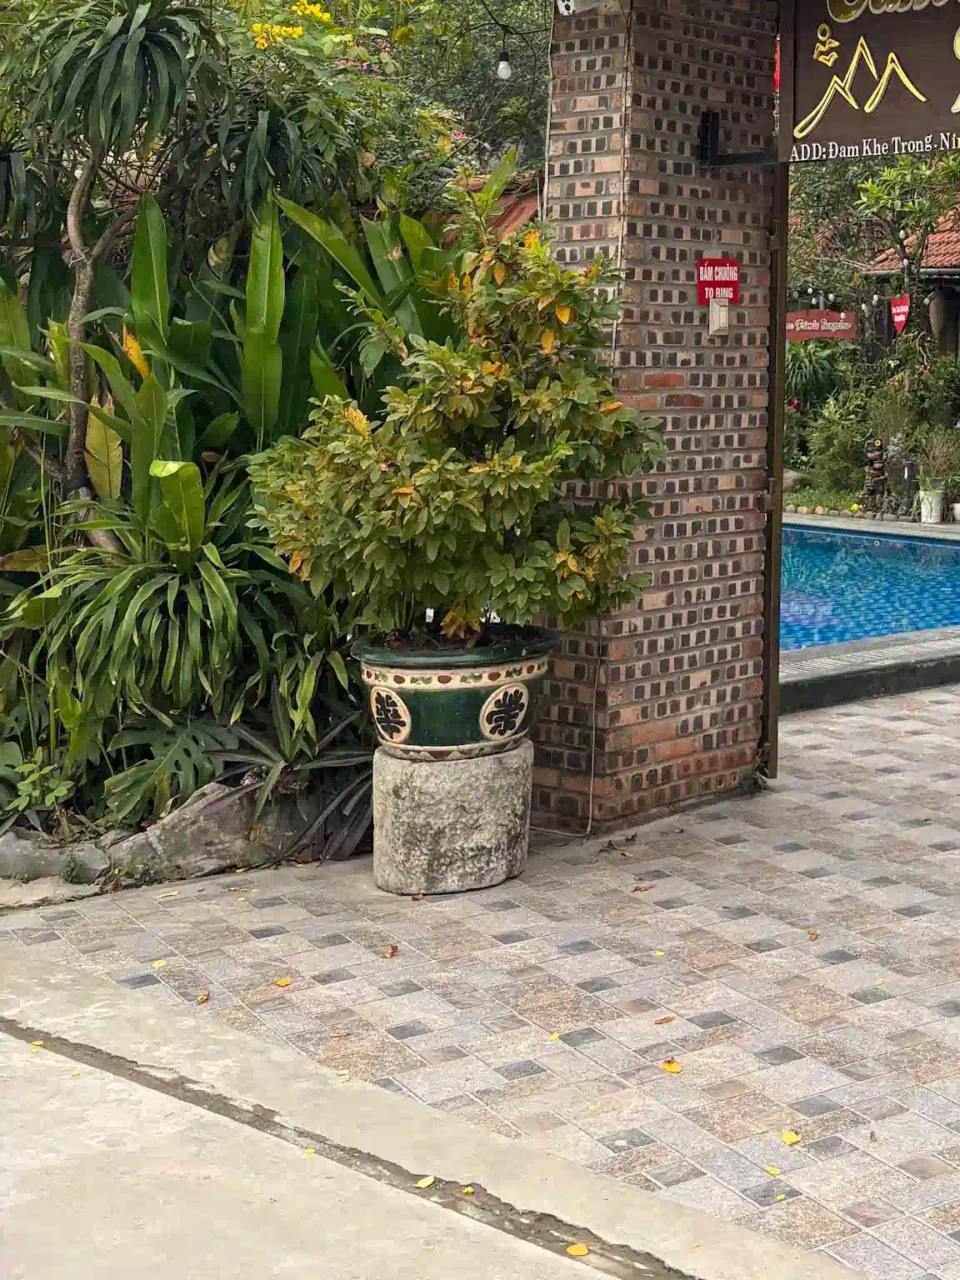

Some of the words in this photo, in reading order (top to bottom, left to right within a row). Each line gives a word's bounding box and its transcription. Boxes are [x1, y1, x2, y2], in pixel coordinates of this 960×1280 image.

[862, 137, 889, 156] Khe
[704, 287, 714, 299] TO
[715, 287, 734, 299] RING
